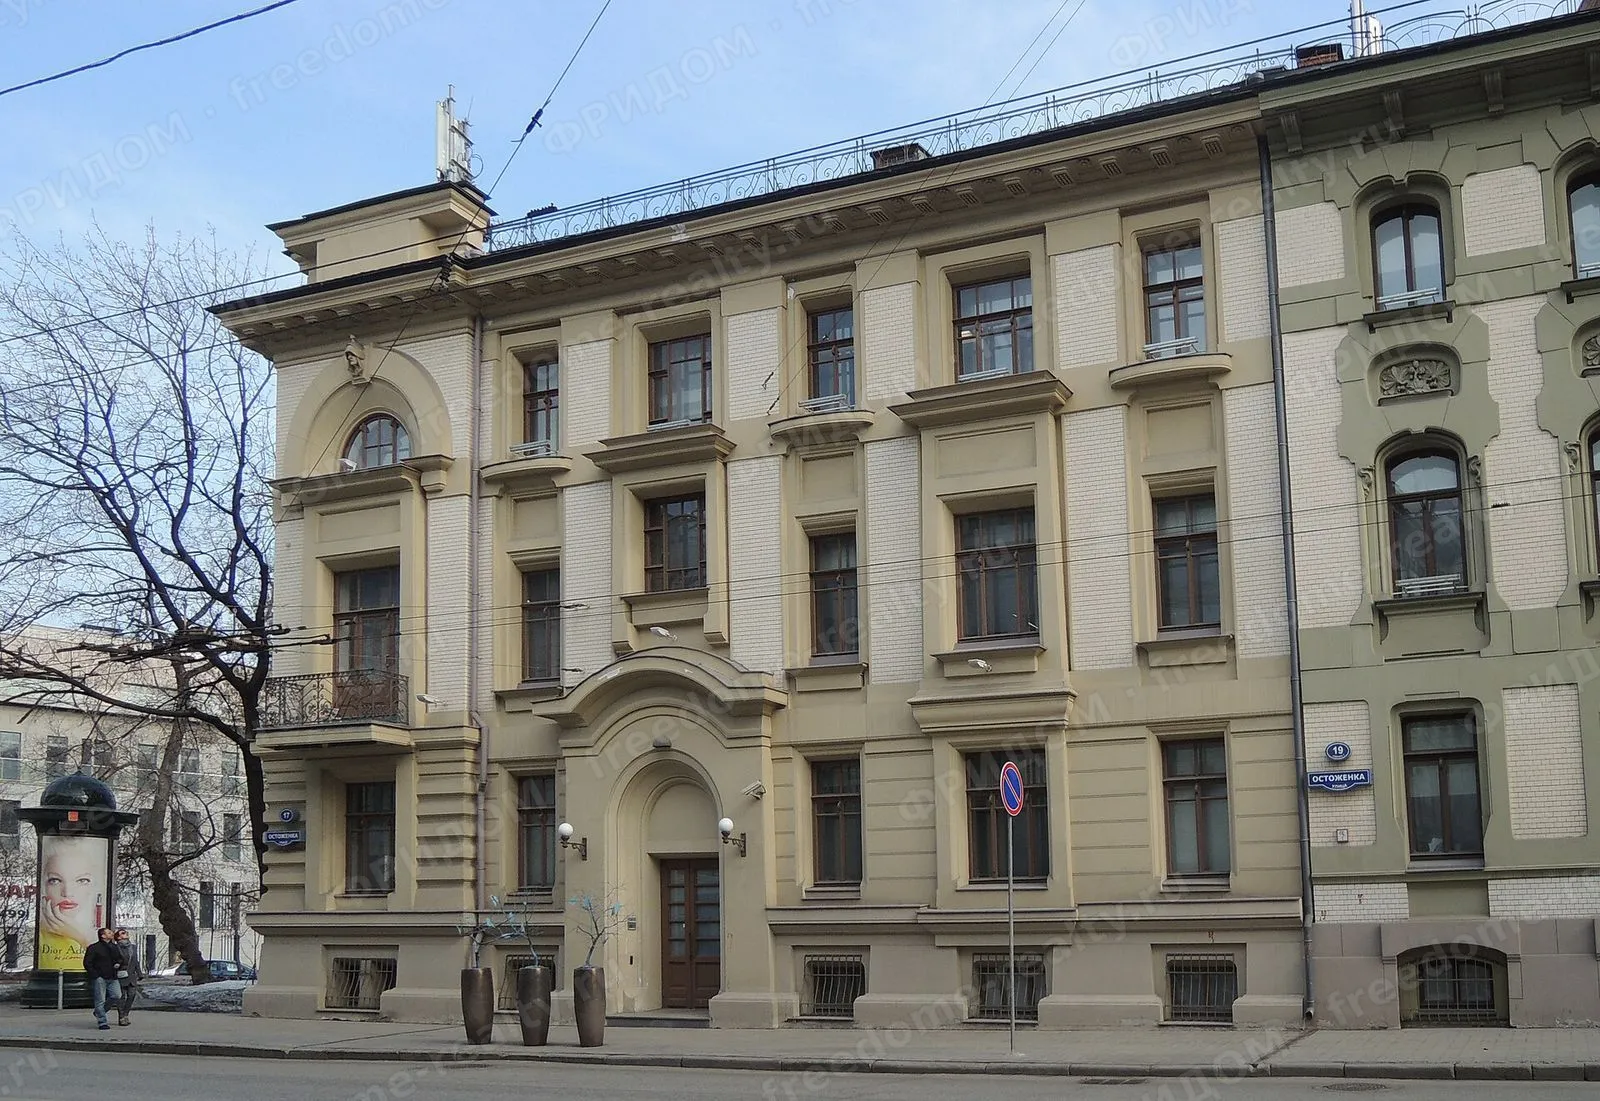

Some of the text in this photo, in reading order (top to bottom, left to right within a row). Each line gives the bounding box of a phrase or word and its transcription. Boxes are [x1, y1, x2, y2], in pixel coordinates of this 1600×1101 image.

[1333, 746, 1344, 755] 19
[1312, 773, 1366, 783] ОСТОЖЕНКА
[42, 944, 62, 954] Dior
